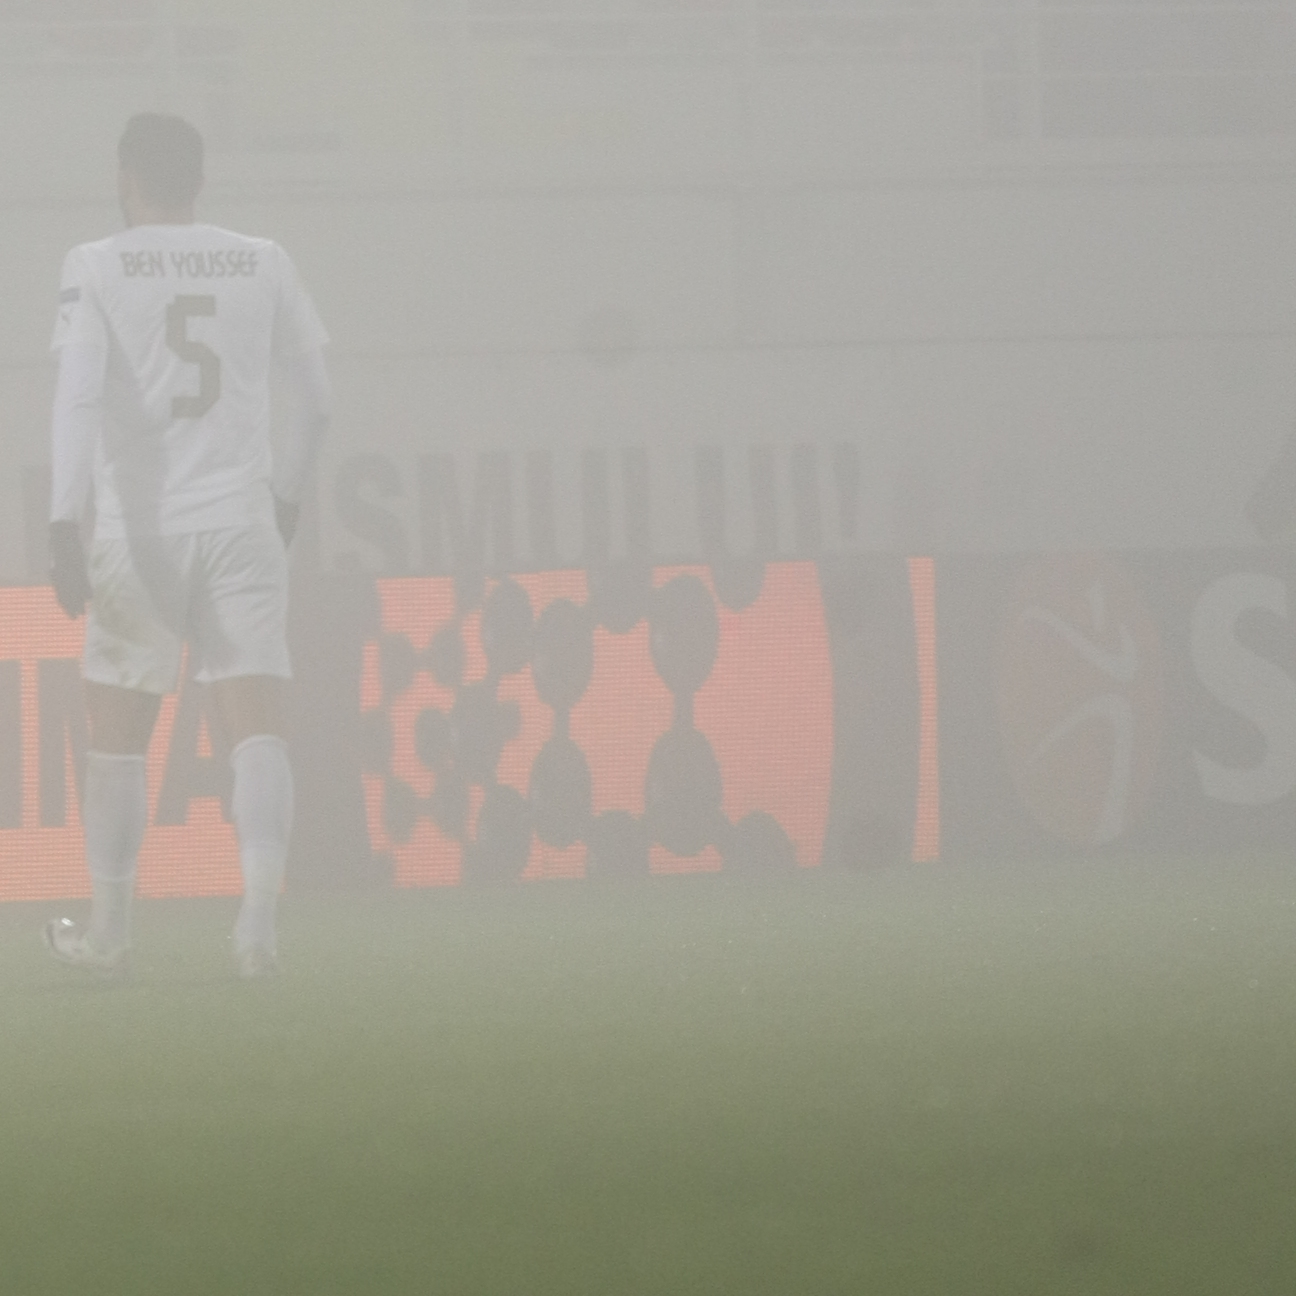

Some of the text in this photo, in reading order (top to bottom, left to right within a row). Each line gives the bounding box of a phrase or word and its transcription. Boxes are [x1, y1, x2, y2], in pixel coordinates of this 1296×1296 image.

[119, 250, 258, 278] BEN YOUSSEF
[164, 294, 222, 419] 5
